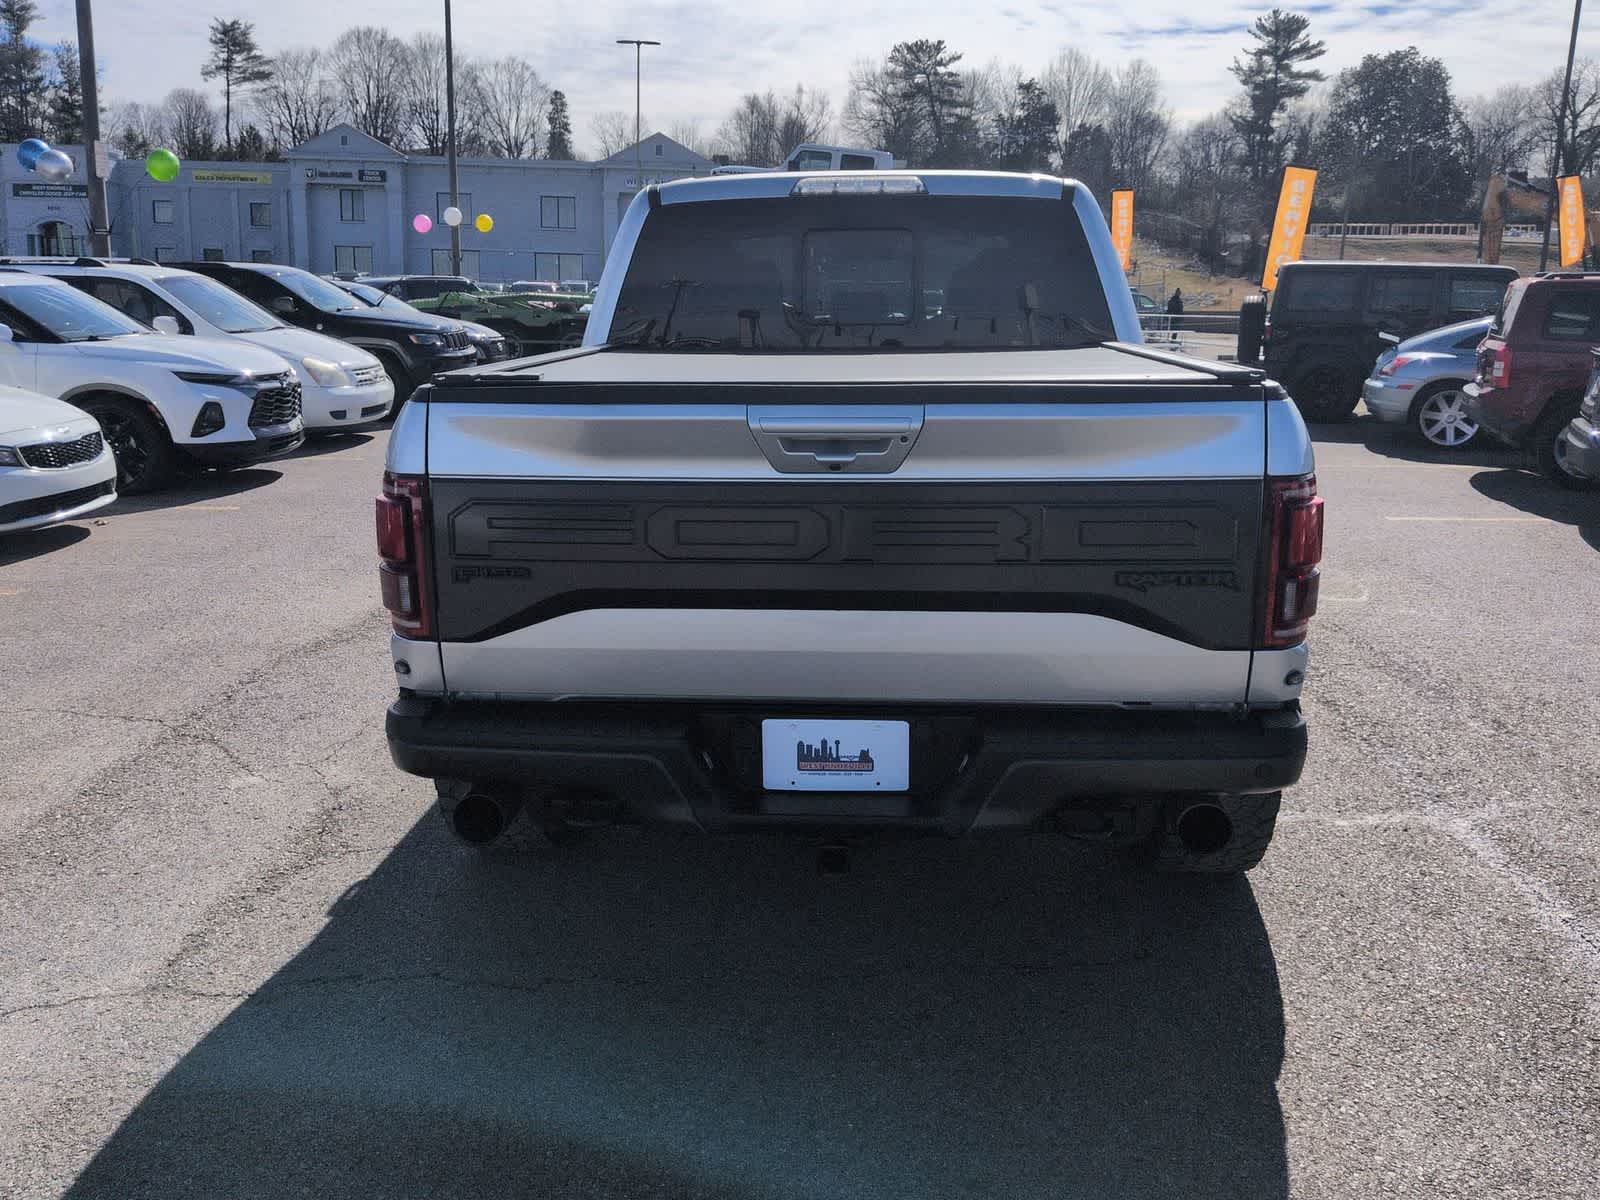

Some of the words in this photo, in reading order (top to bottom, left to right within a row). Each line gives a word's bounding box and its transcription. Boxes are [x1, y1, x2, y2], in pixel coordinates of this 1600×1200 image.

[1276, 180, 1305, 263] SERVIC
[449, 500, 1239, 562] FORD
[1115, 570, 1239, 592] RAPTOR
